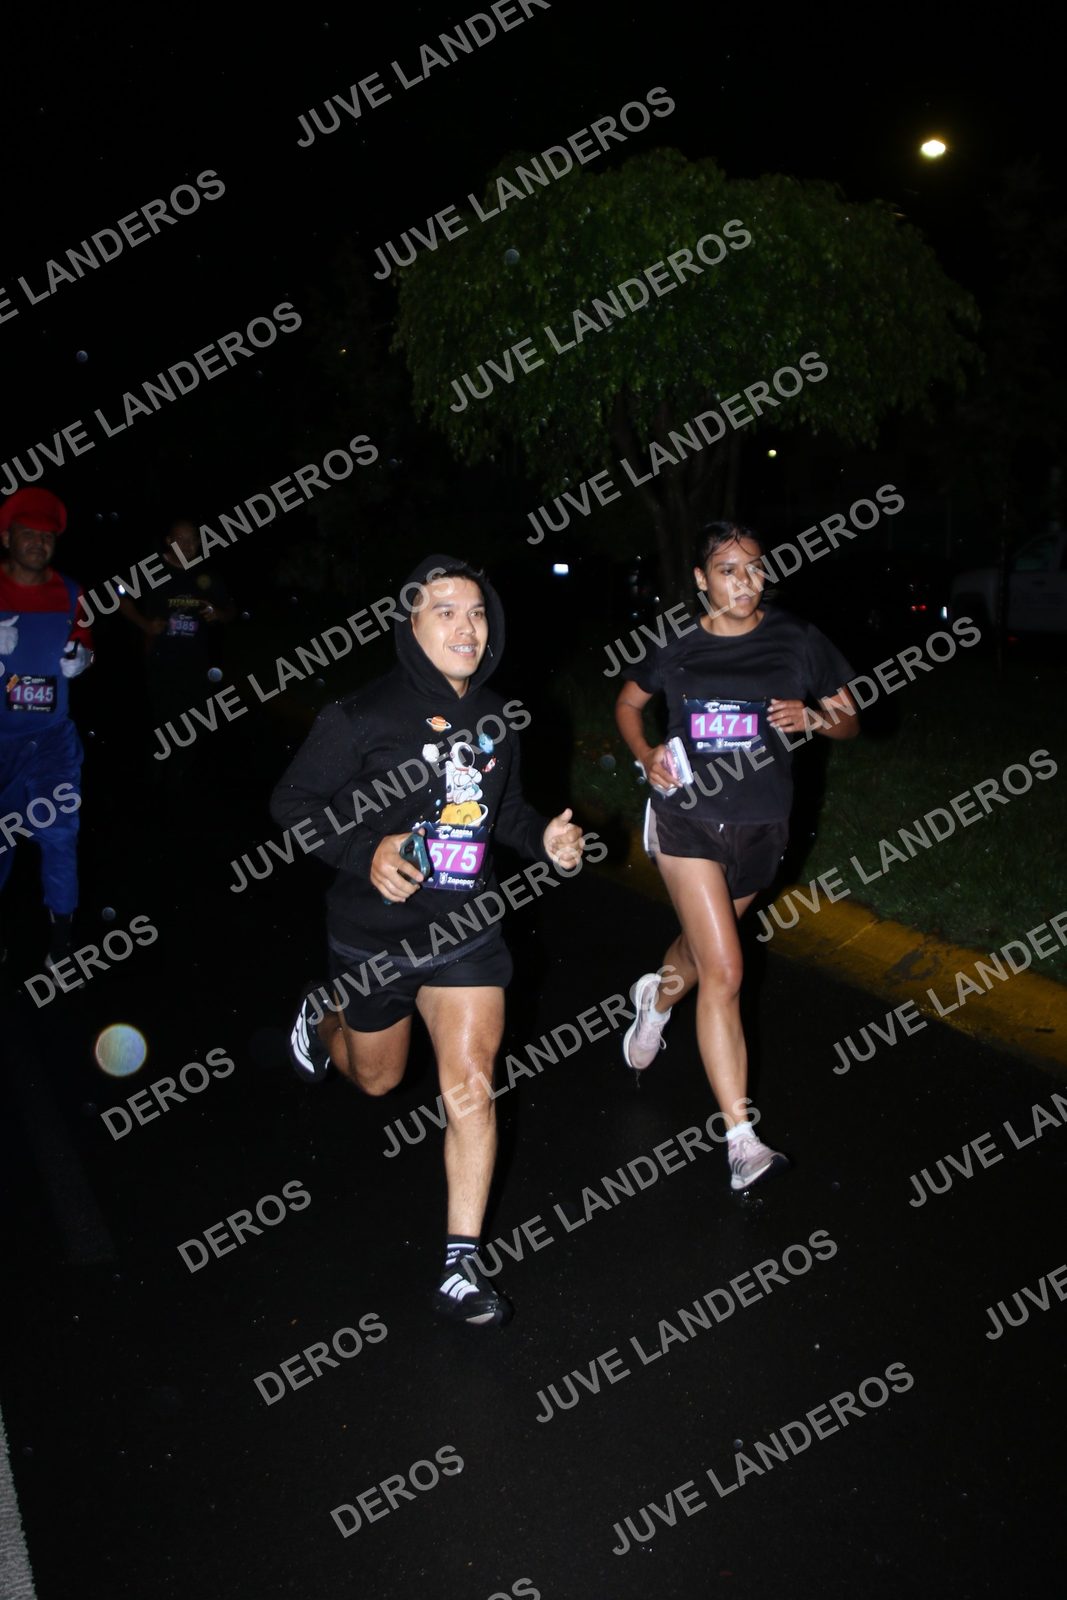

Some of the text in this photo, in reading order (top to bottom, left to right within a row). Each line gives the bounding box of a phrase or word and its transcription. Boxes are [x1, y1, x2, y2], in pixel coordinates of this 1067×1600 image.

[13, 685, 54, 702] 1645
[694, 714, 754, 737] 1471
[430, 842, 478, 872] 575
